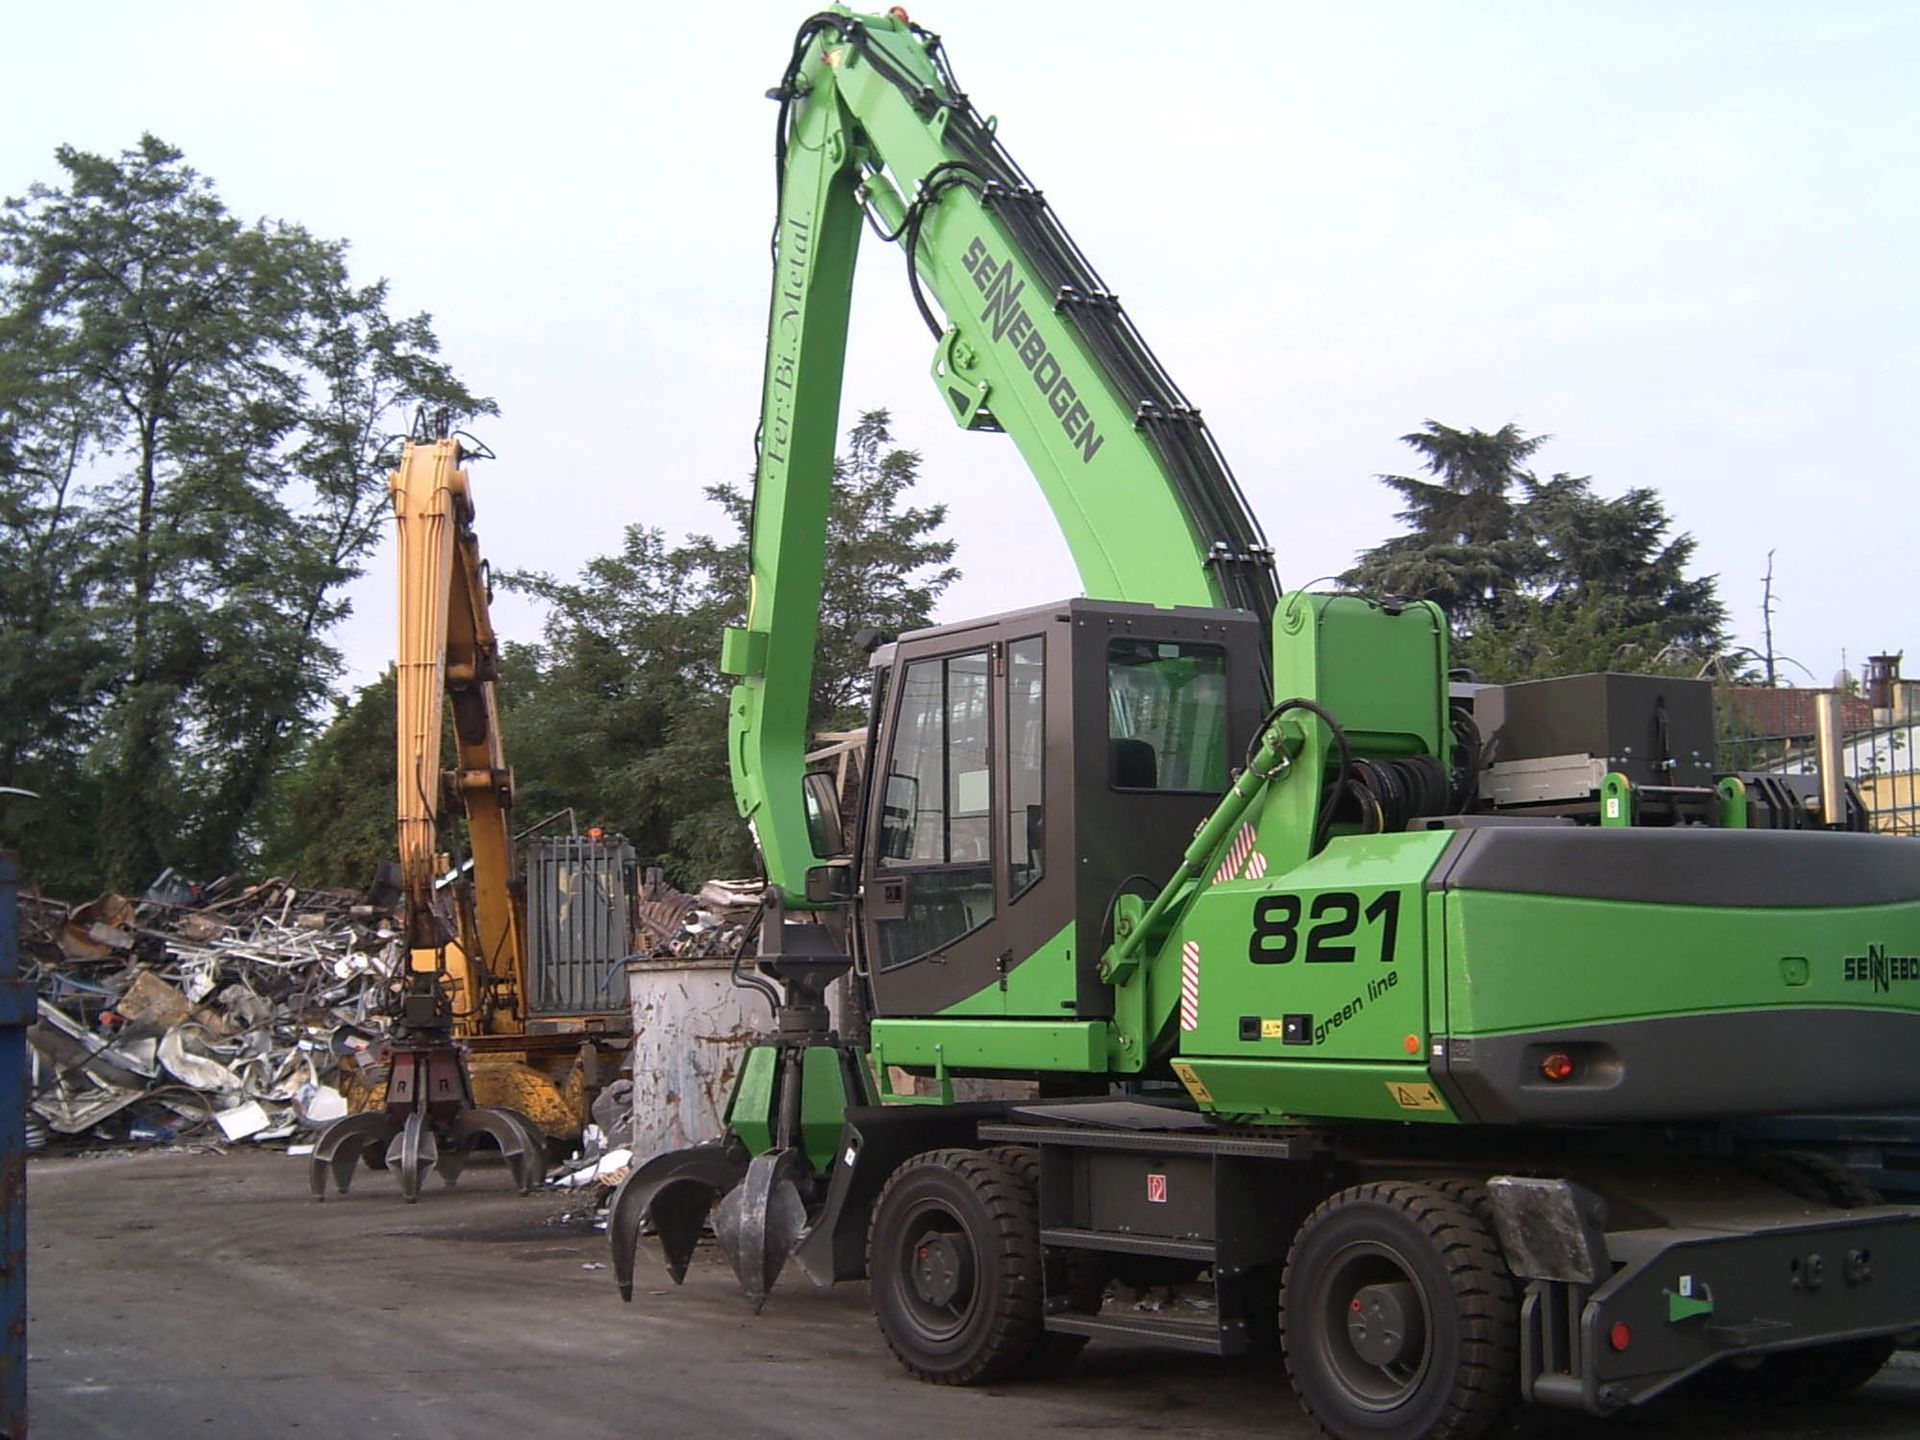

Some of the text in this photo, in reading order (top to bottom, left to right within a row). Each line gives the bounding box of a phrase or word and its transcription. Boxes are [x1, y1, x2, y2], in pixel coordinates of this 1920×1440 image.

[961, 236, 1105, 464] SENNEBOGEN
[1249, 891, 1402, 964] 821
[1314, 970, 1400, 1046] green line
